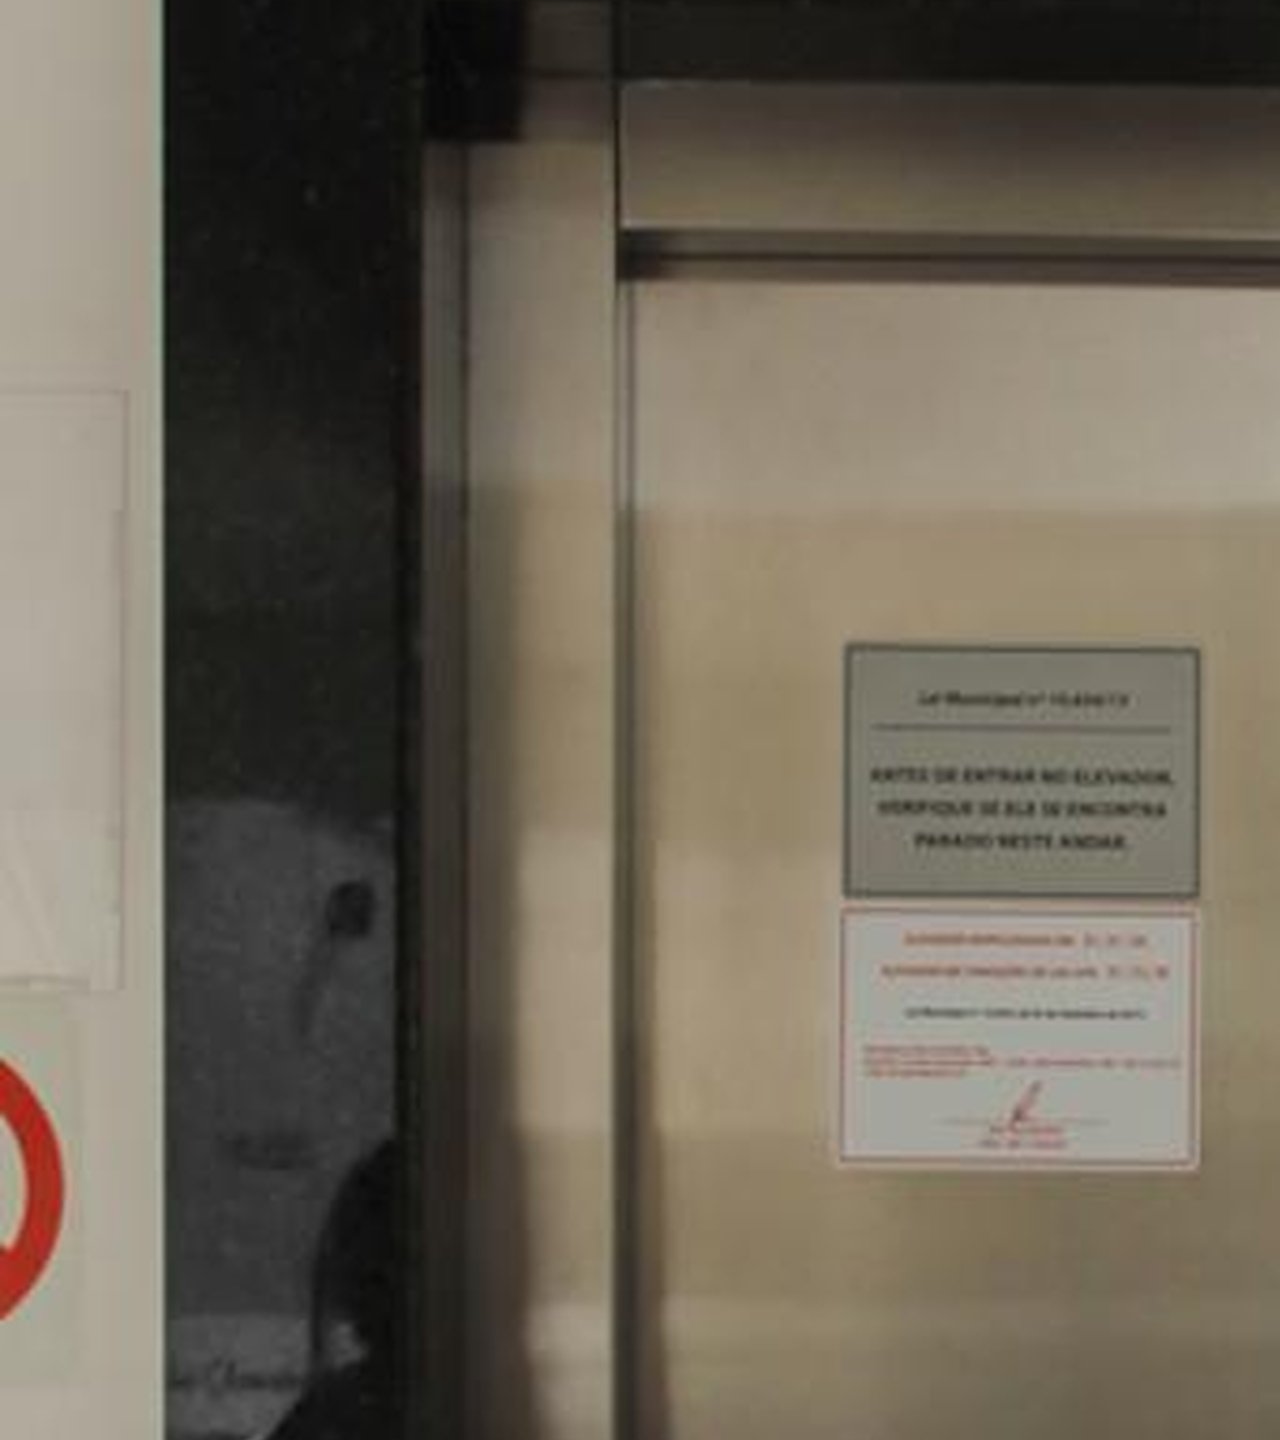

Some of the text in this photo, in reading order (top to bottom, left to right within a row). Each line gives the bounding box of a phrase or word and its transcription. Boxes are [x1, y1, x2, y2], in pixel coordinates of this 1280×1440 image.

[933, 767, 958, 784] DE
[962, 767, 1035, 784] ENTRAR
[1040, 767, 1067, 784] NO
[1066, 799, 1167, 818] ENCONTRA
[913, 832, 993, 851] PARADO
[998, 832, 1052, 851] NESTE
